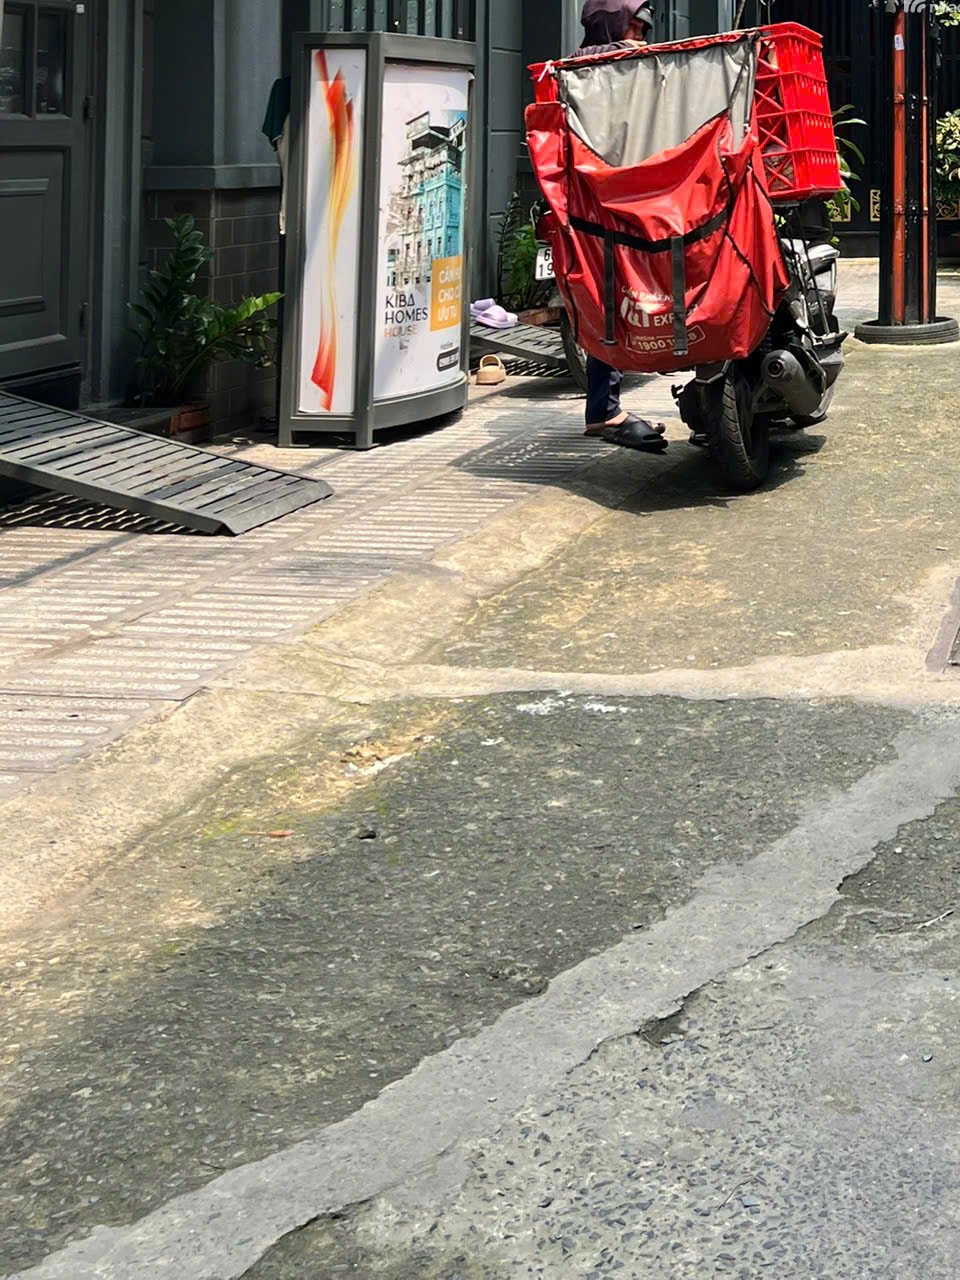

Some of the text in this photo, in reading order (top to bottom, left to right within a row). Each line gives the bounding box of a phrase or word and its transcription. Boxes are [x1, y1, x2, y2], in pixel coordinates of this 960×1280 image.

[385, 293, 416, 309] KIBA
[384, 307, 429, 325] HOMES
[383, 324, 418, 338] HOUSE
[637, 340, 667, 351] 1900
